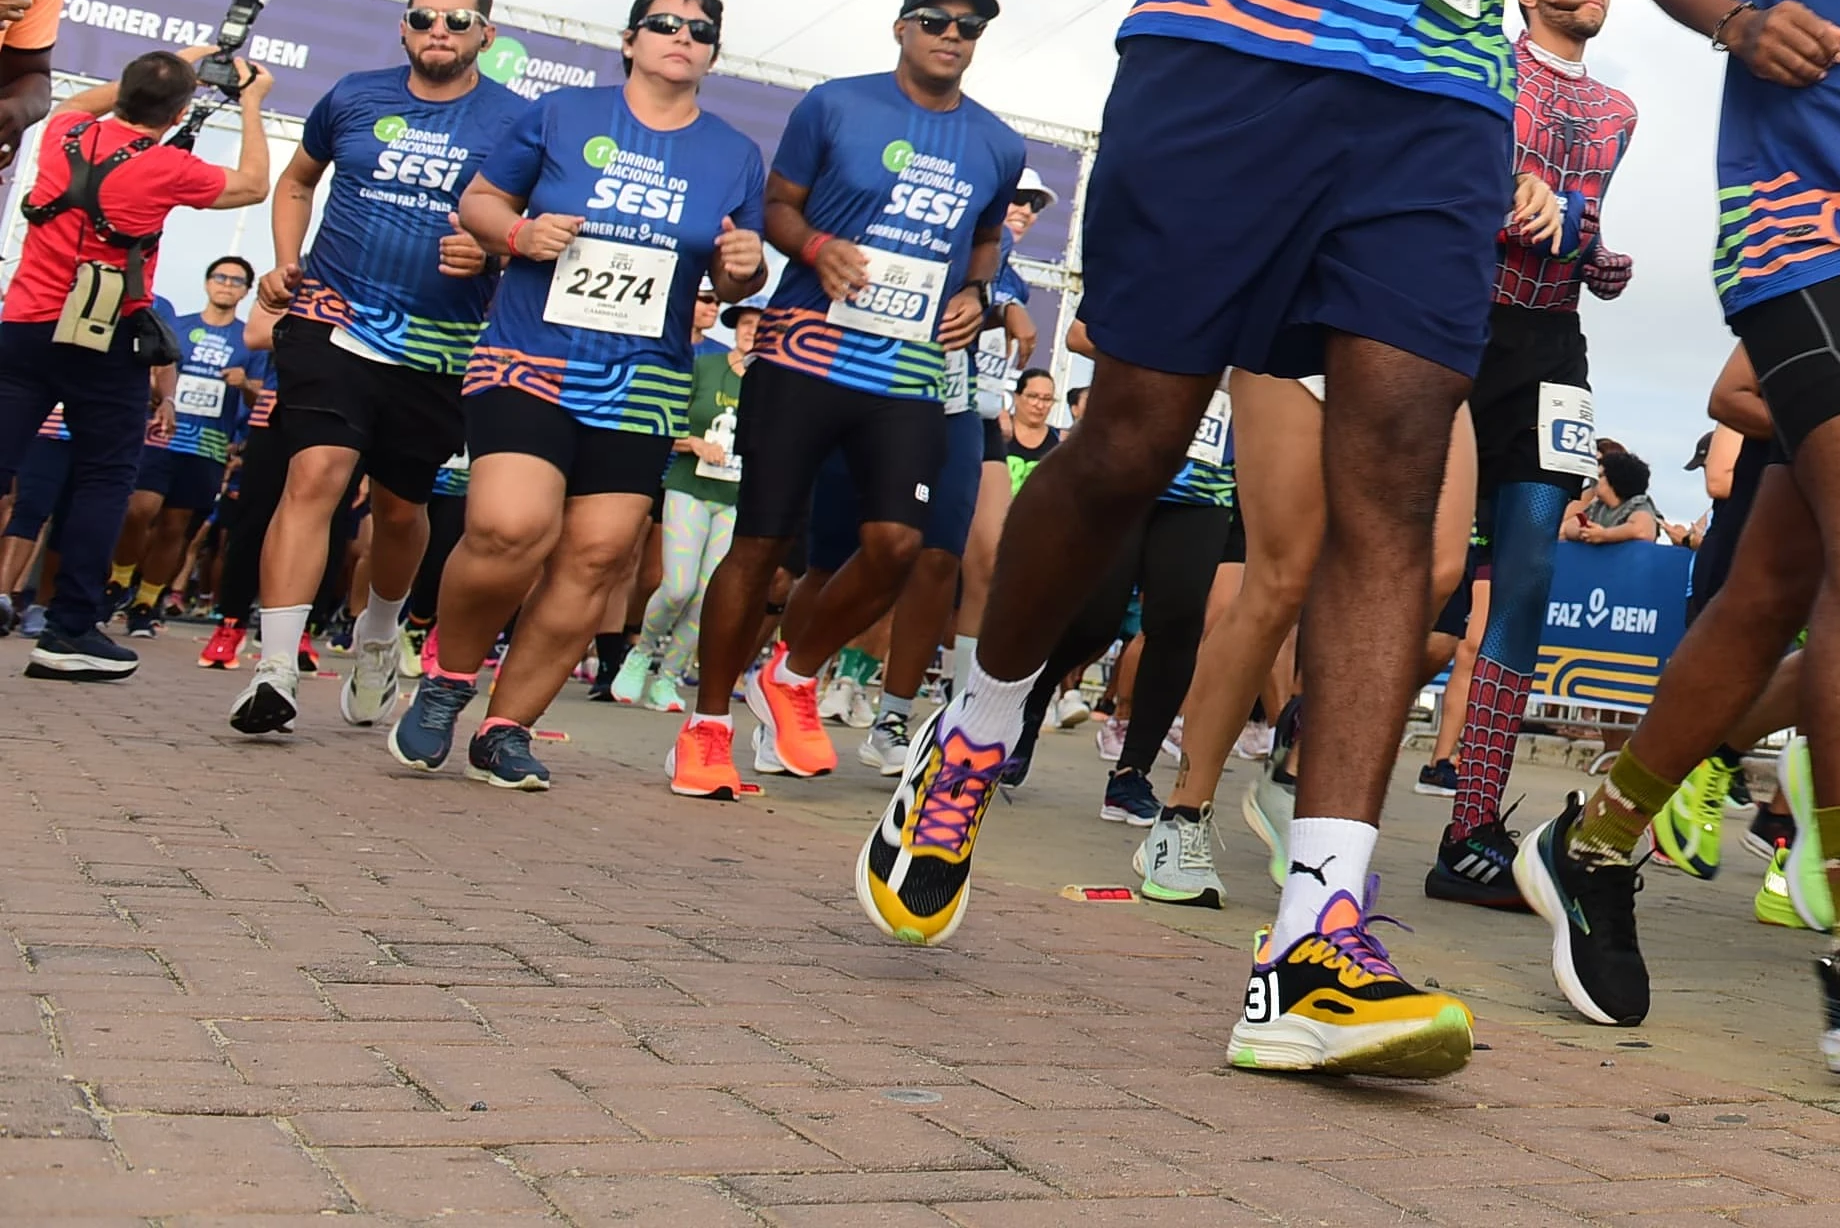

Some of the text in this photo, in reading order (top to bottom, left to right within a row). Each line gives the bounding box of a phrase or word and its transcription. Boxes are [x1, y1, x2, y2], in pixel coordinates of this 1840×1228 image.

[162, 17, 213, 47] FAZ
[248, 35, 308, 69] BEM
[513, 56, 596, 89] CORRIDA
[387, 138, 469, 161] NACIONAL DO
[397, 127, 450, 145] CORRIDA
[609, 149, 665, 174] CORRIDA
[905, 152, 956, 176] CORRIDA
[603, 162, 689, 193] NACIONAL DO
[898, 167, 974, 198] NACIONAL DO
[615, 225, 637, 240] FAZ
[565, 267, 656, 306] 2274
[1547, 602, 1583, 628] FAZ
[1610, 606, 1658, 634] BEM
